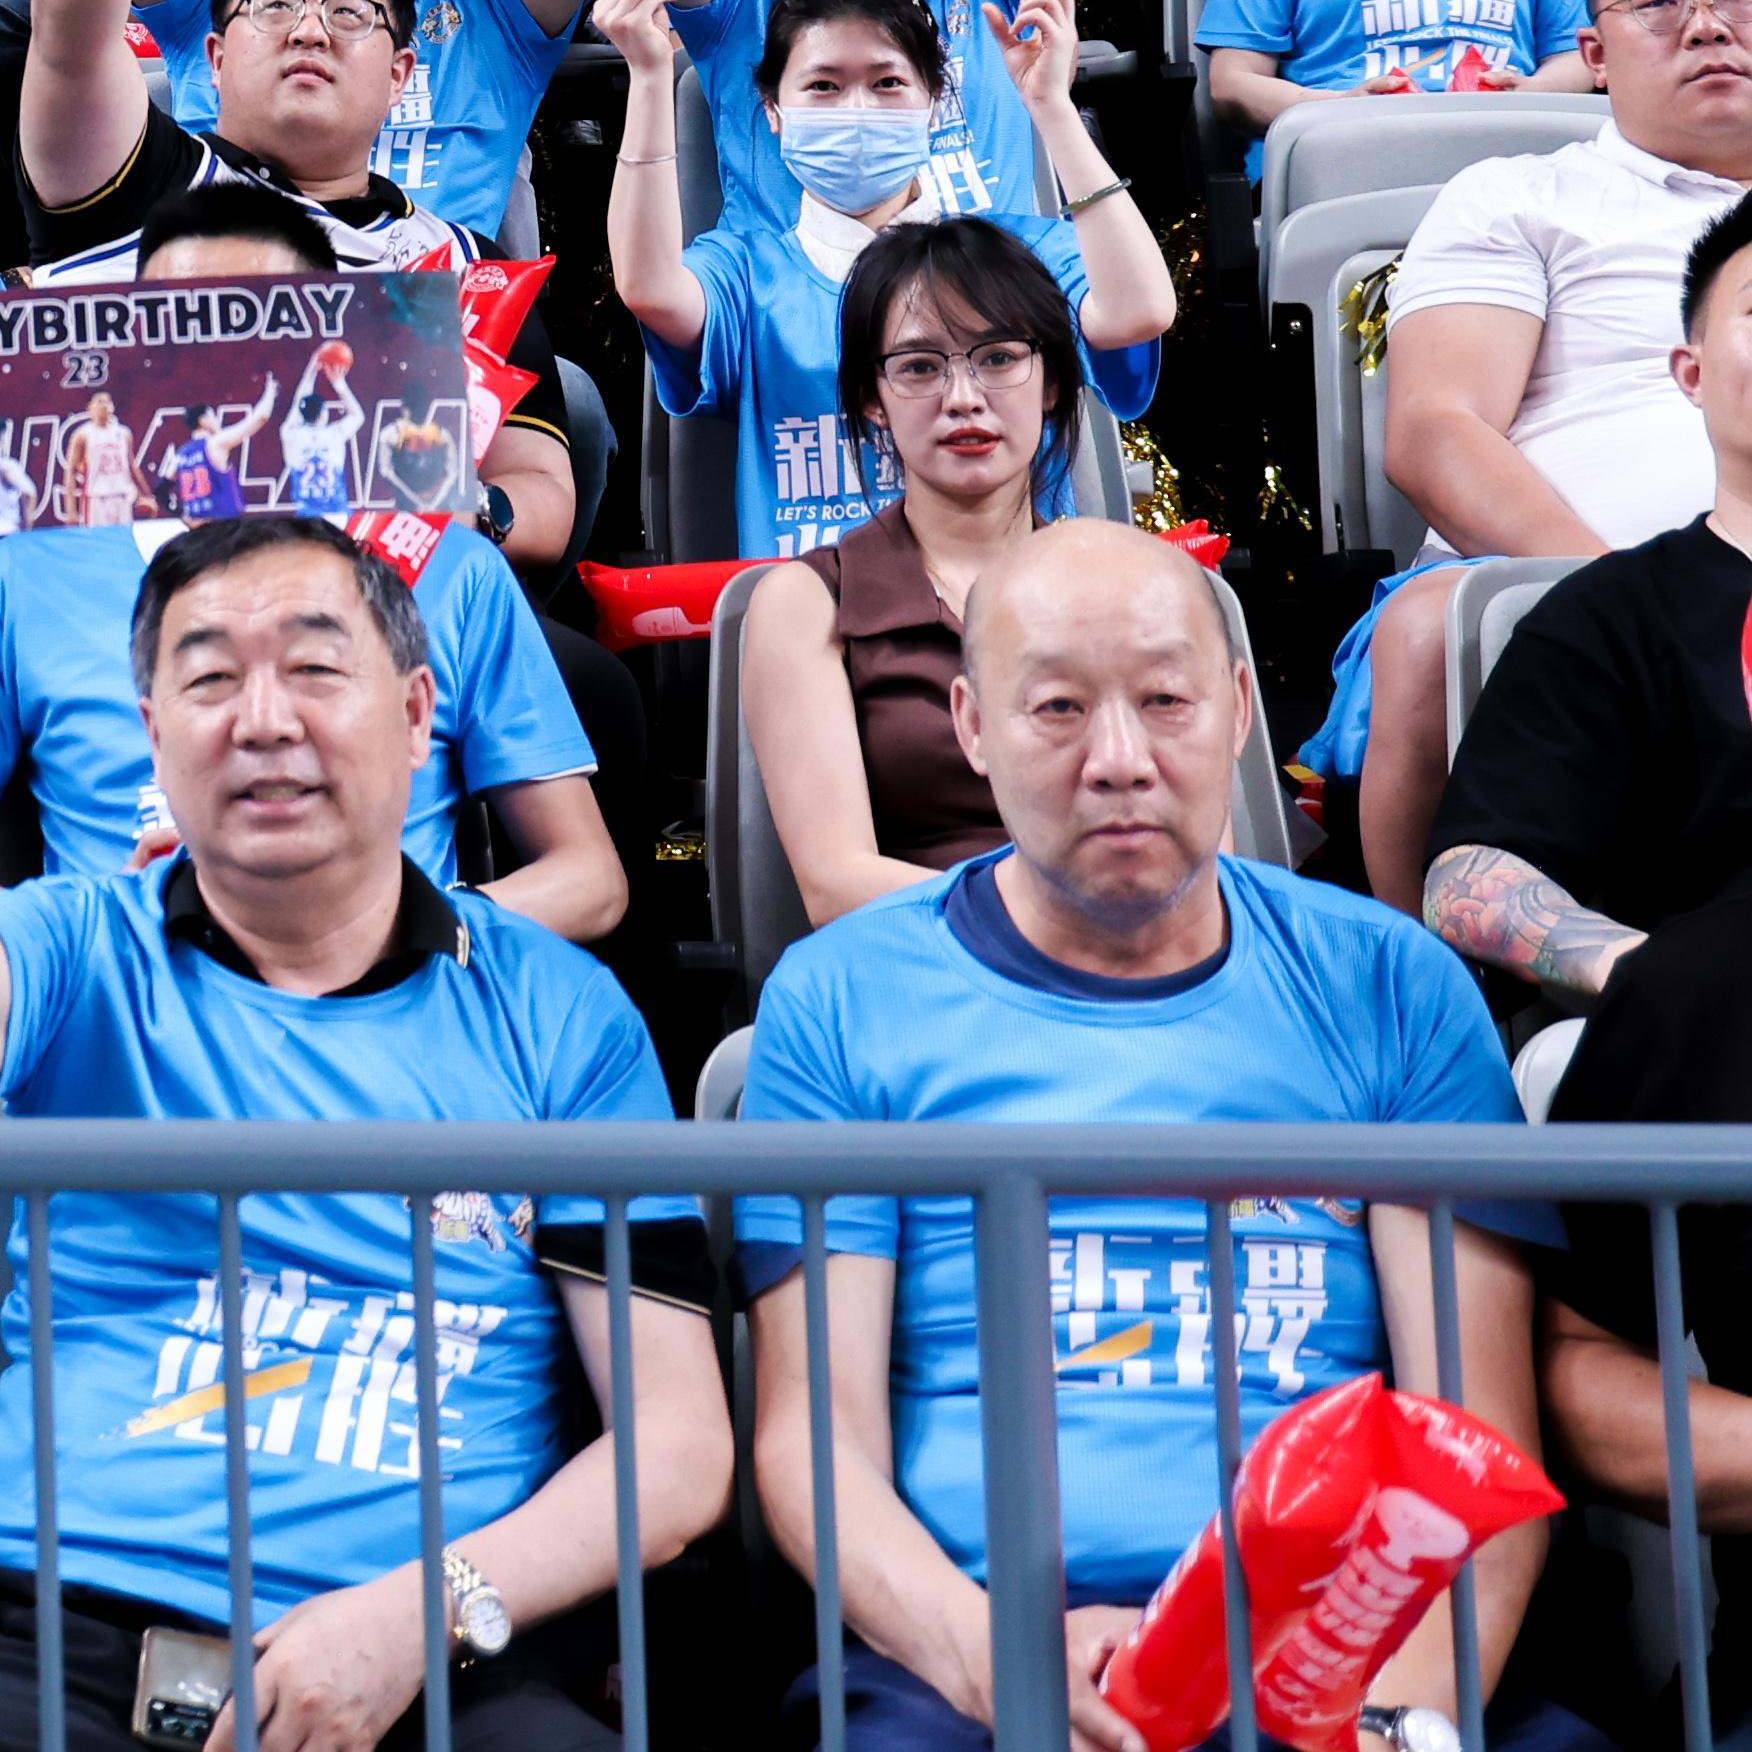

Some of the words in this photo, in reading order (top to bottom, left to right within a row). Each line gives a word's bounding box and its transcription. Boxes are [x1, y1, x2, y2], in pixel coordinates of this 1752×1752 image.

[61, 351, 109, 388] 23
[775, 504, 817, 523] LET'S
[820, 501, 872, 521] ROCK
